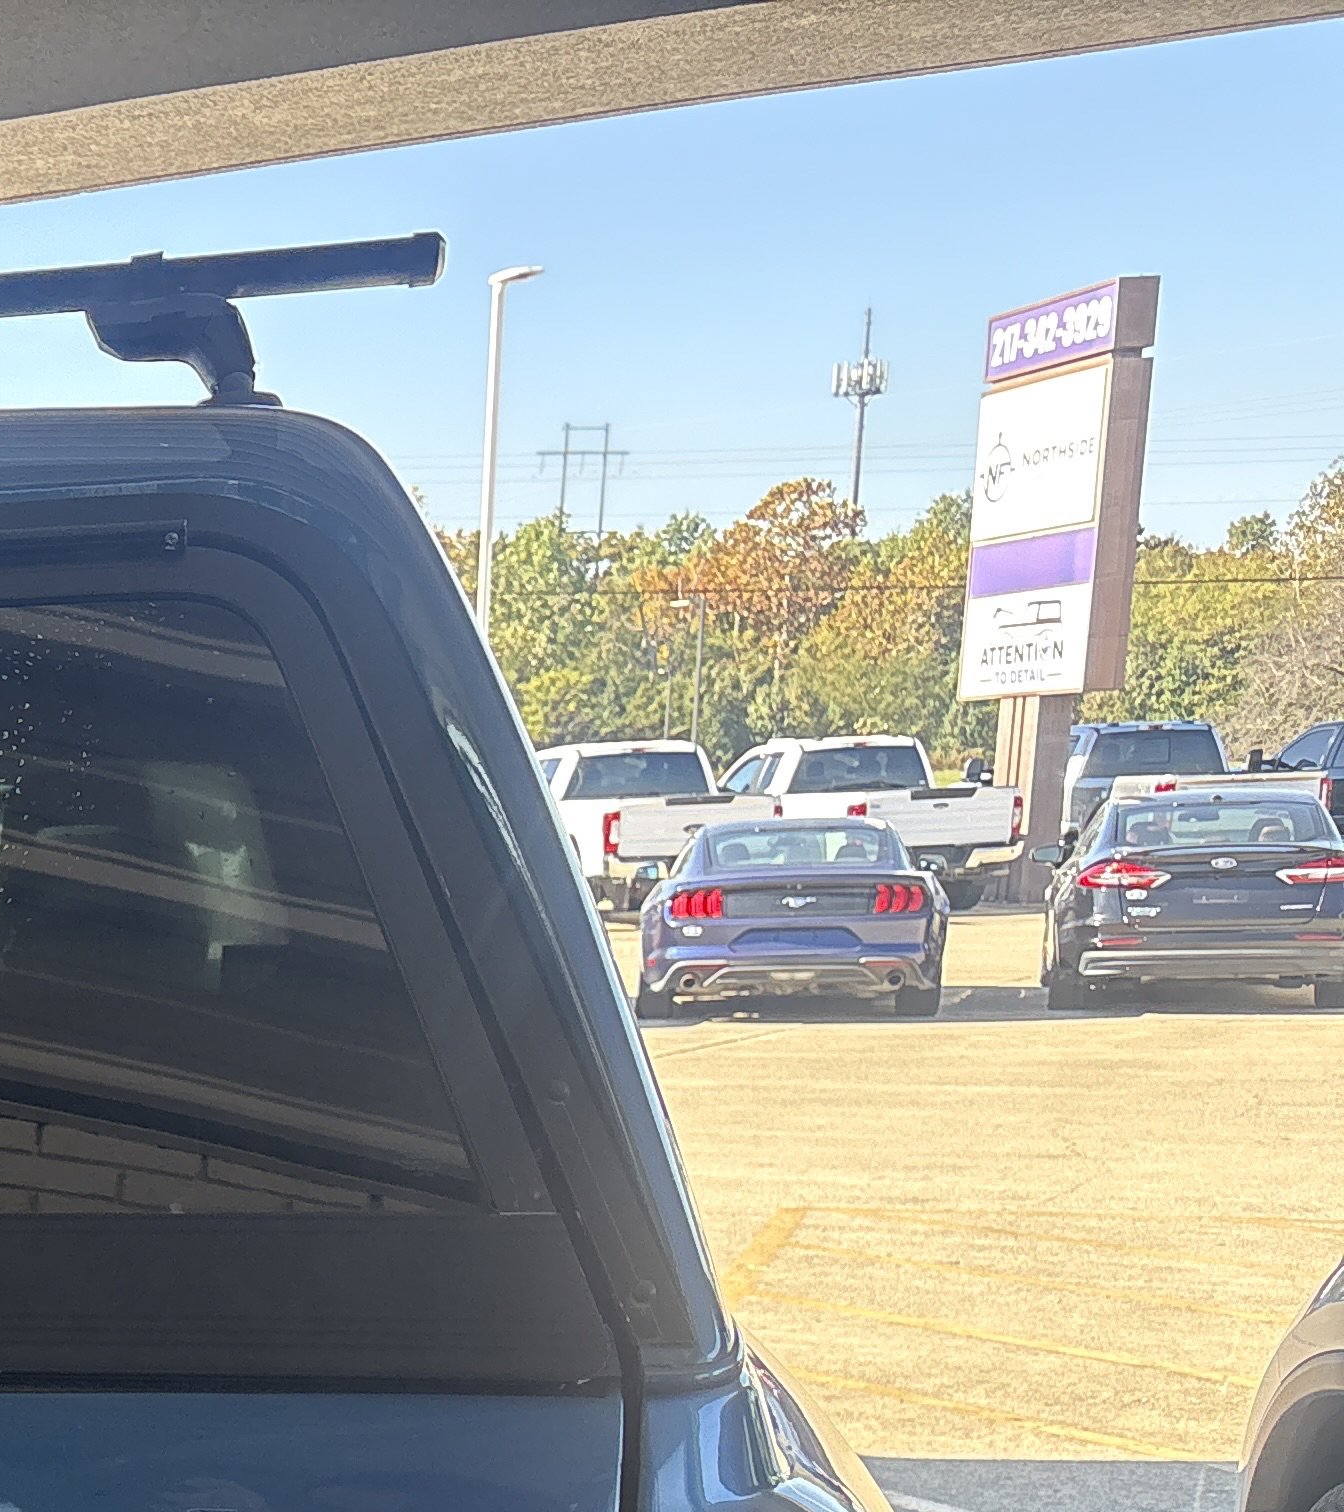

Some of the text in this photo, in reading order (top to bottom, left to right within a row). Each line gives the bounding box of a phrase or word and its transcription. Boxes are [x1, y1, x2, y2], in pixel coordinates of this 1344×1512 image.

[991, 296, 1112, 368] 217-342-3929
[1023, 437, 1095, 466] NORTHSIDE
[995, 668, 1045, 685] TO DETAIL
